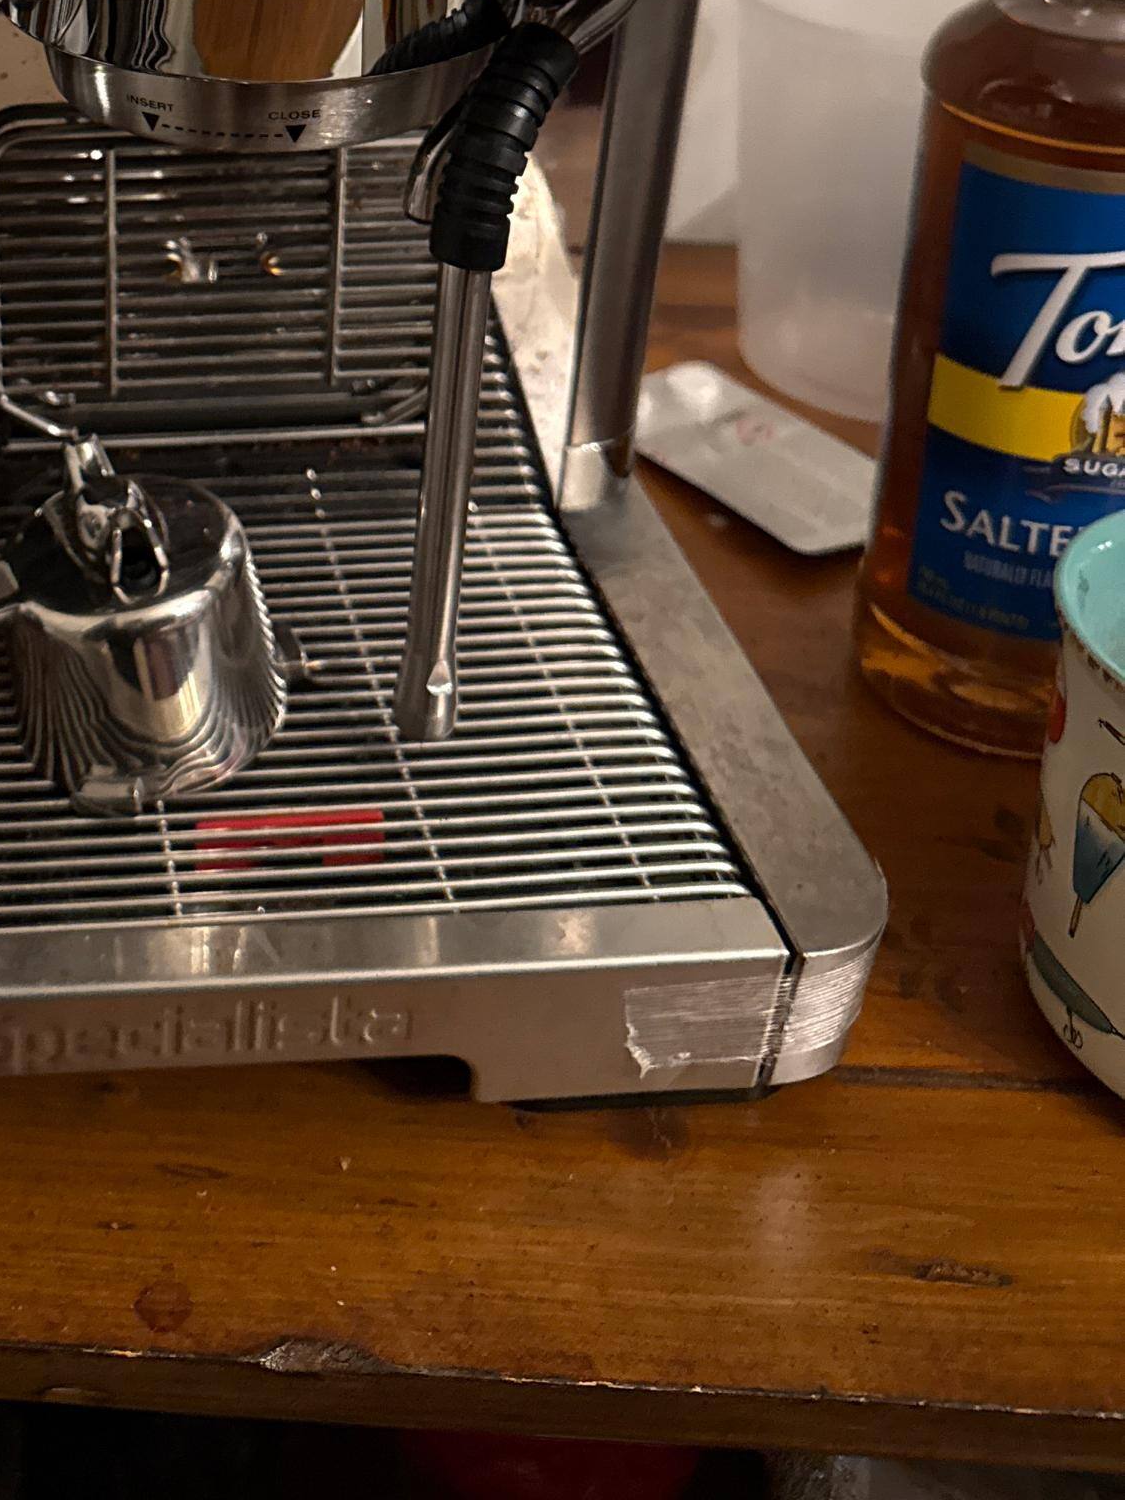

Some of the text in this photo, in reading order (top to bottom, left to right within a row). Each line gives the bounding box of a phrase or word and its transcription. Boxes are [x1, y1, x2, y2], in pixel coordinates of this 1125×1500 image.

[126, 94, 175, 113] INSERT
[268, 109, 321, 121] CLOSE
[939, 489, 1088, 559] SALTE
